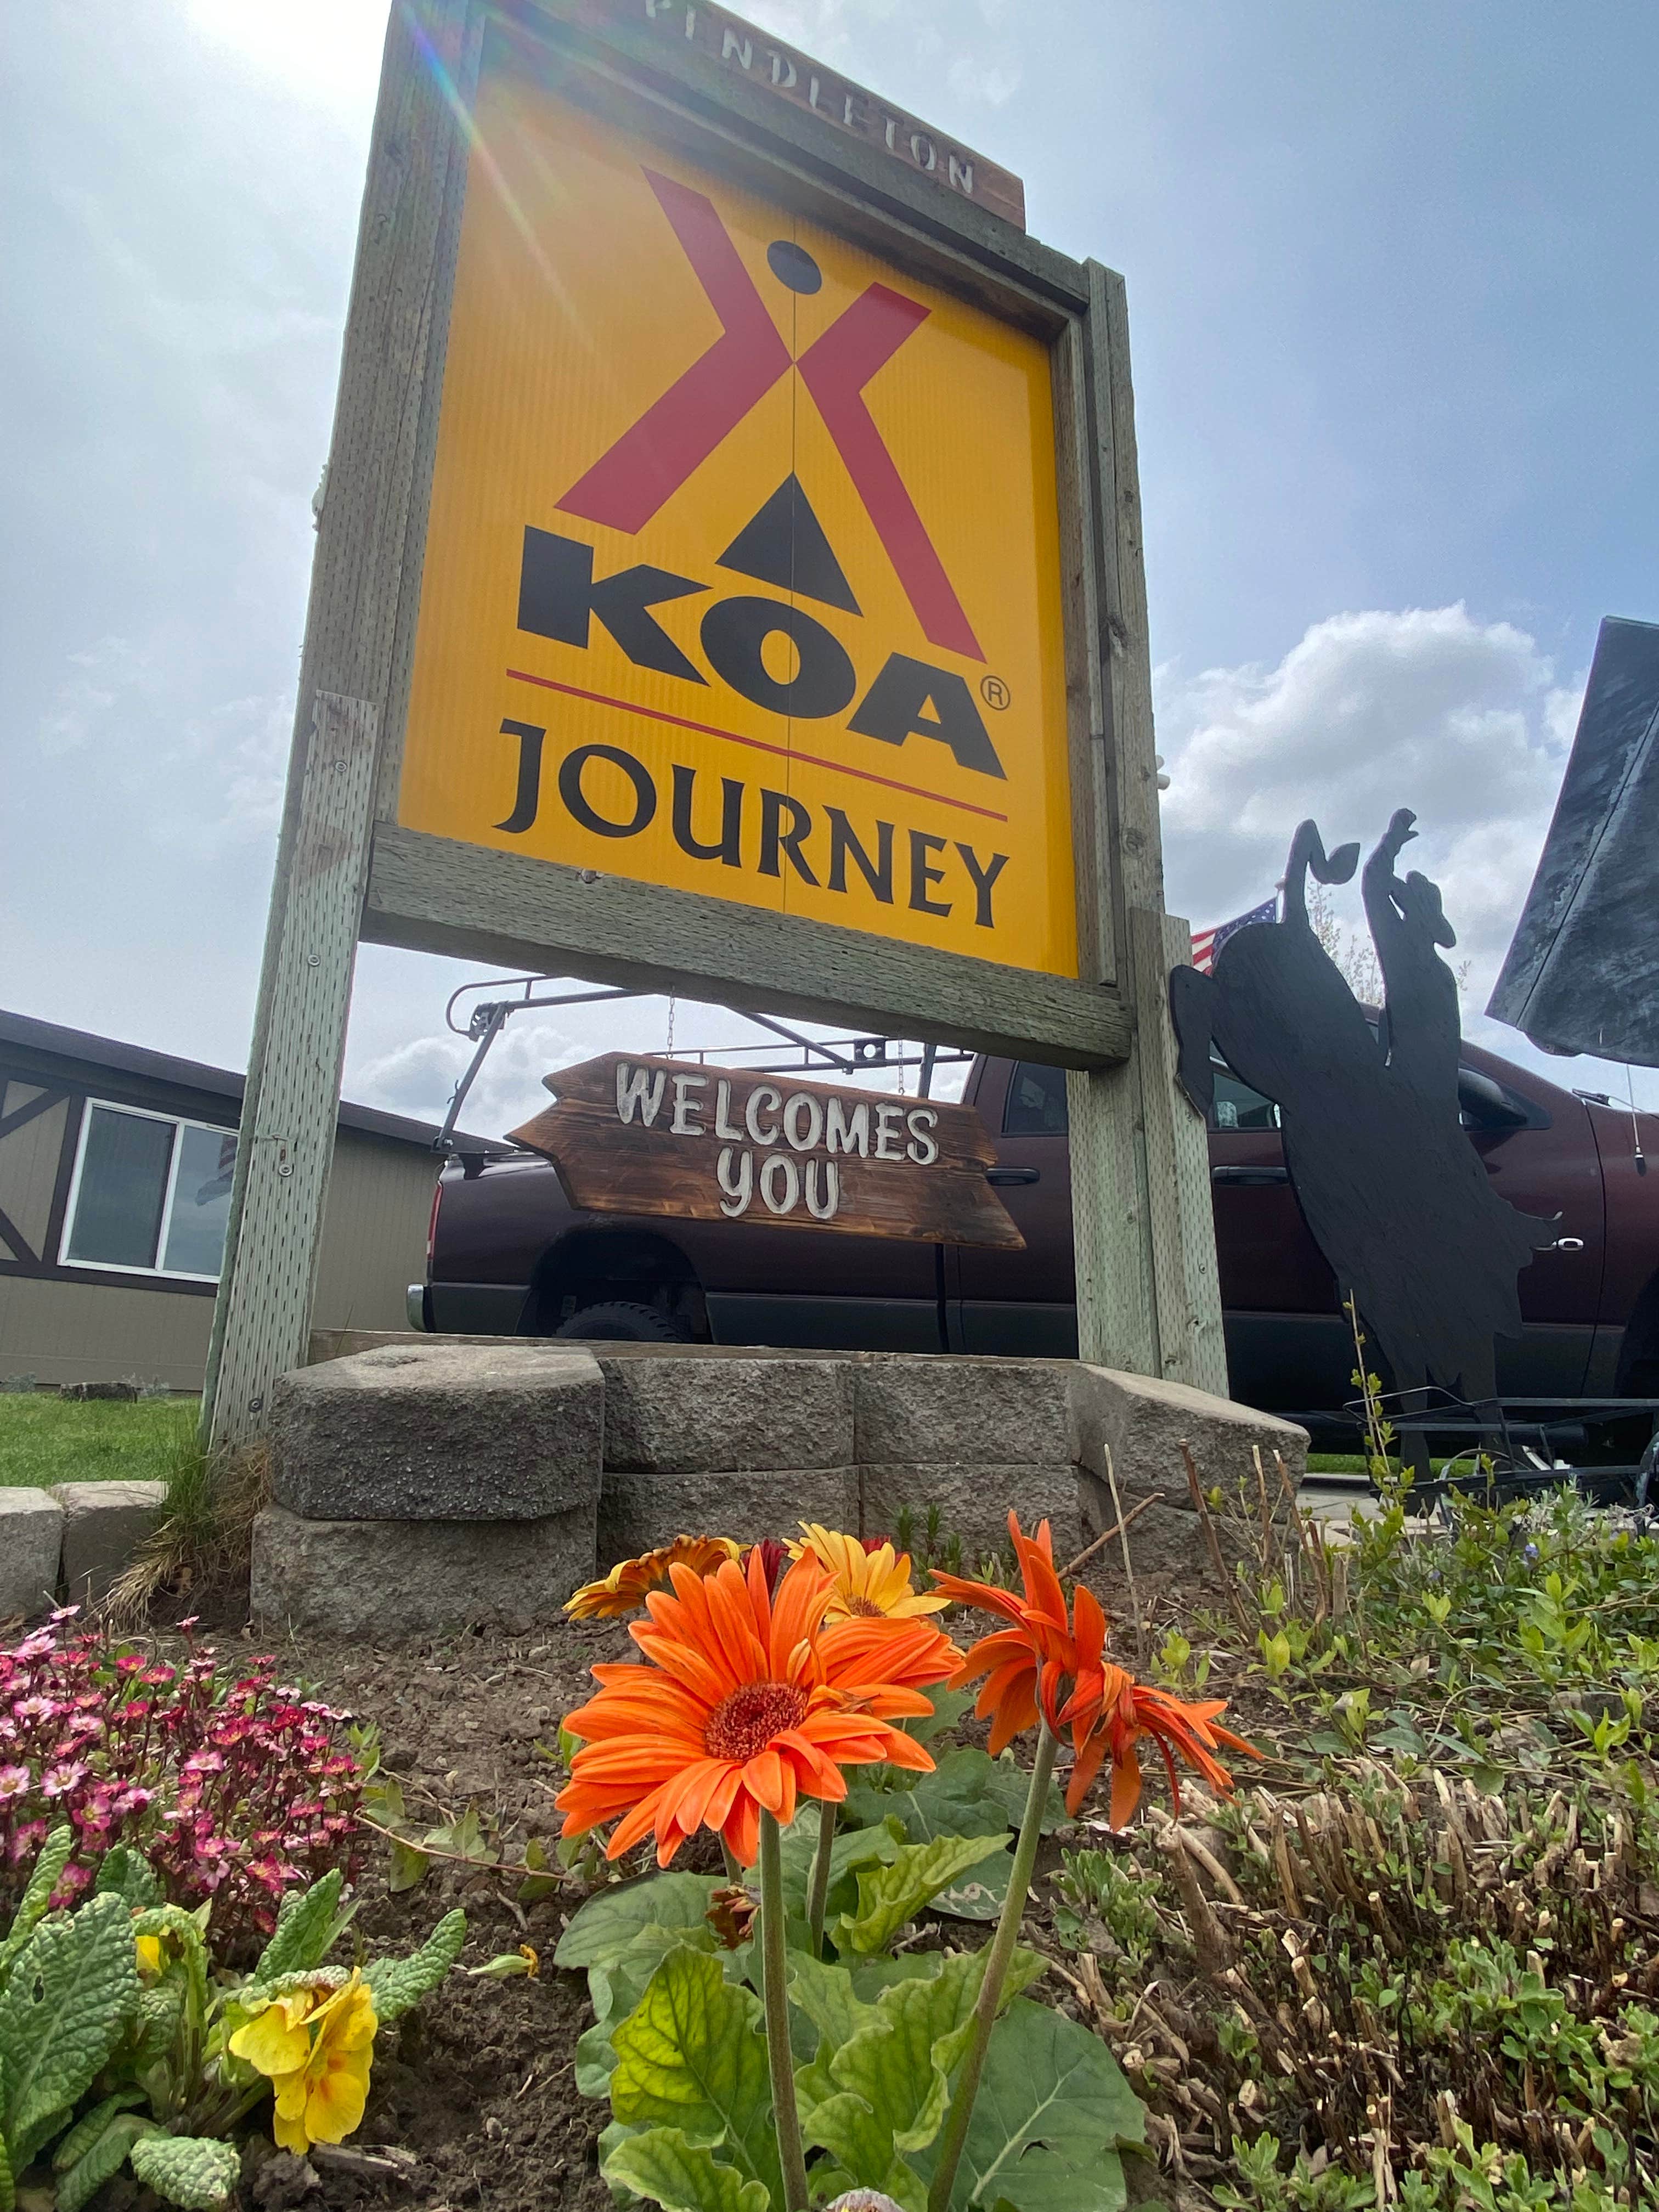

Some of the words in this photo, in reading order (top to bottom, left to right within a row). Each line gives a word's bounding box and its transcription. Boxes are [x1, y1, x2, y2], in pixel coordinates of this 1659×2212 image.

[517, 524, 1008, 780] KOA
[492, 718, 1010, 928] JOURNEY
[616, 1062, 940, 1165] WELCOMES
[717, 1146, 839, 1219] YOU
